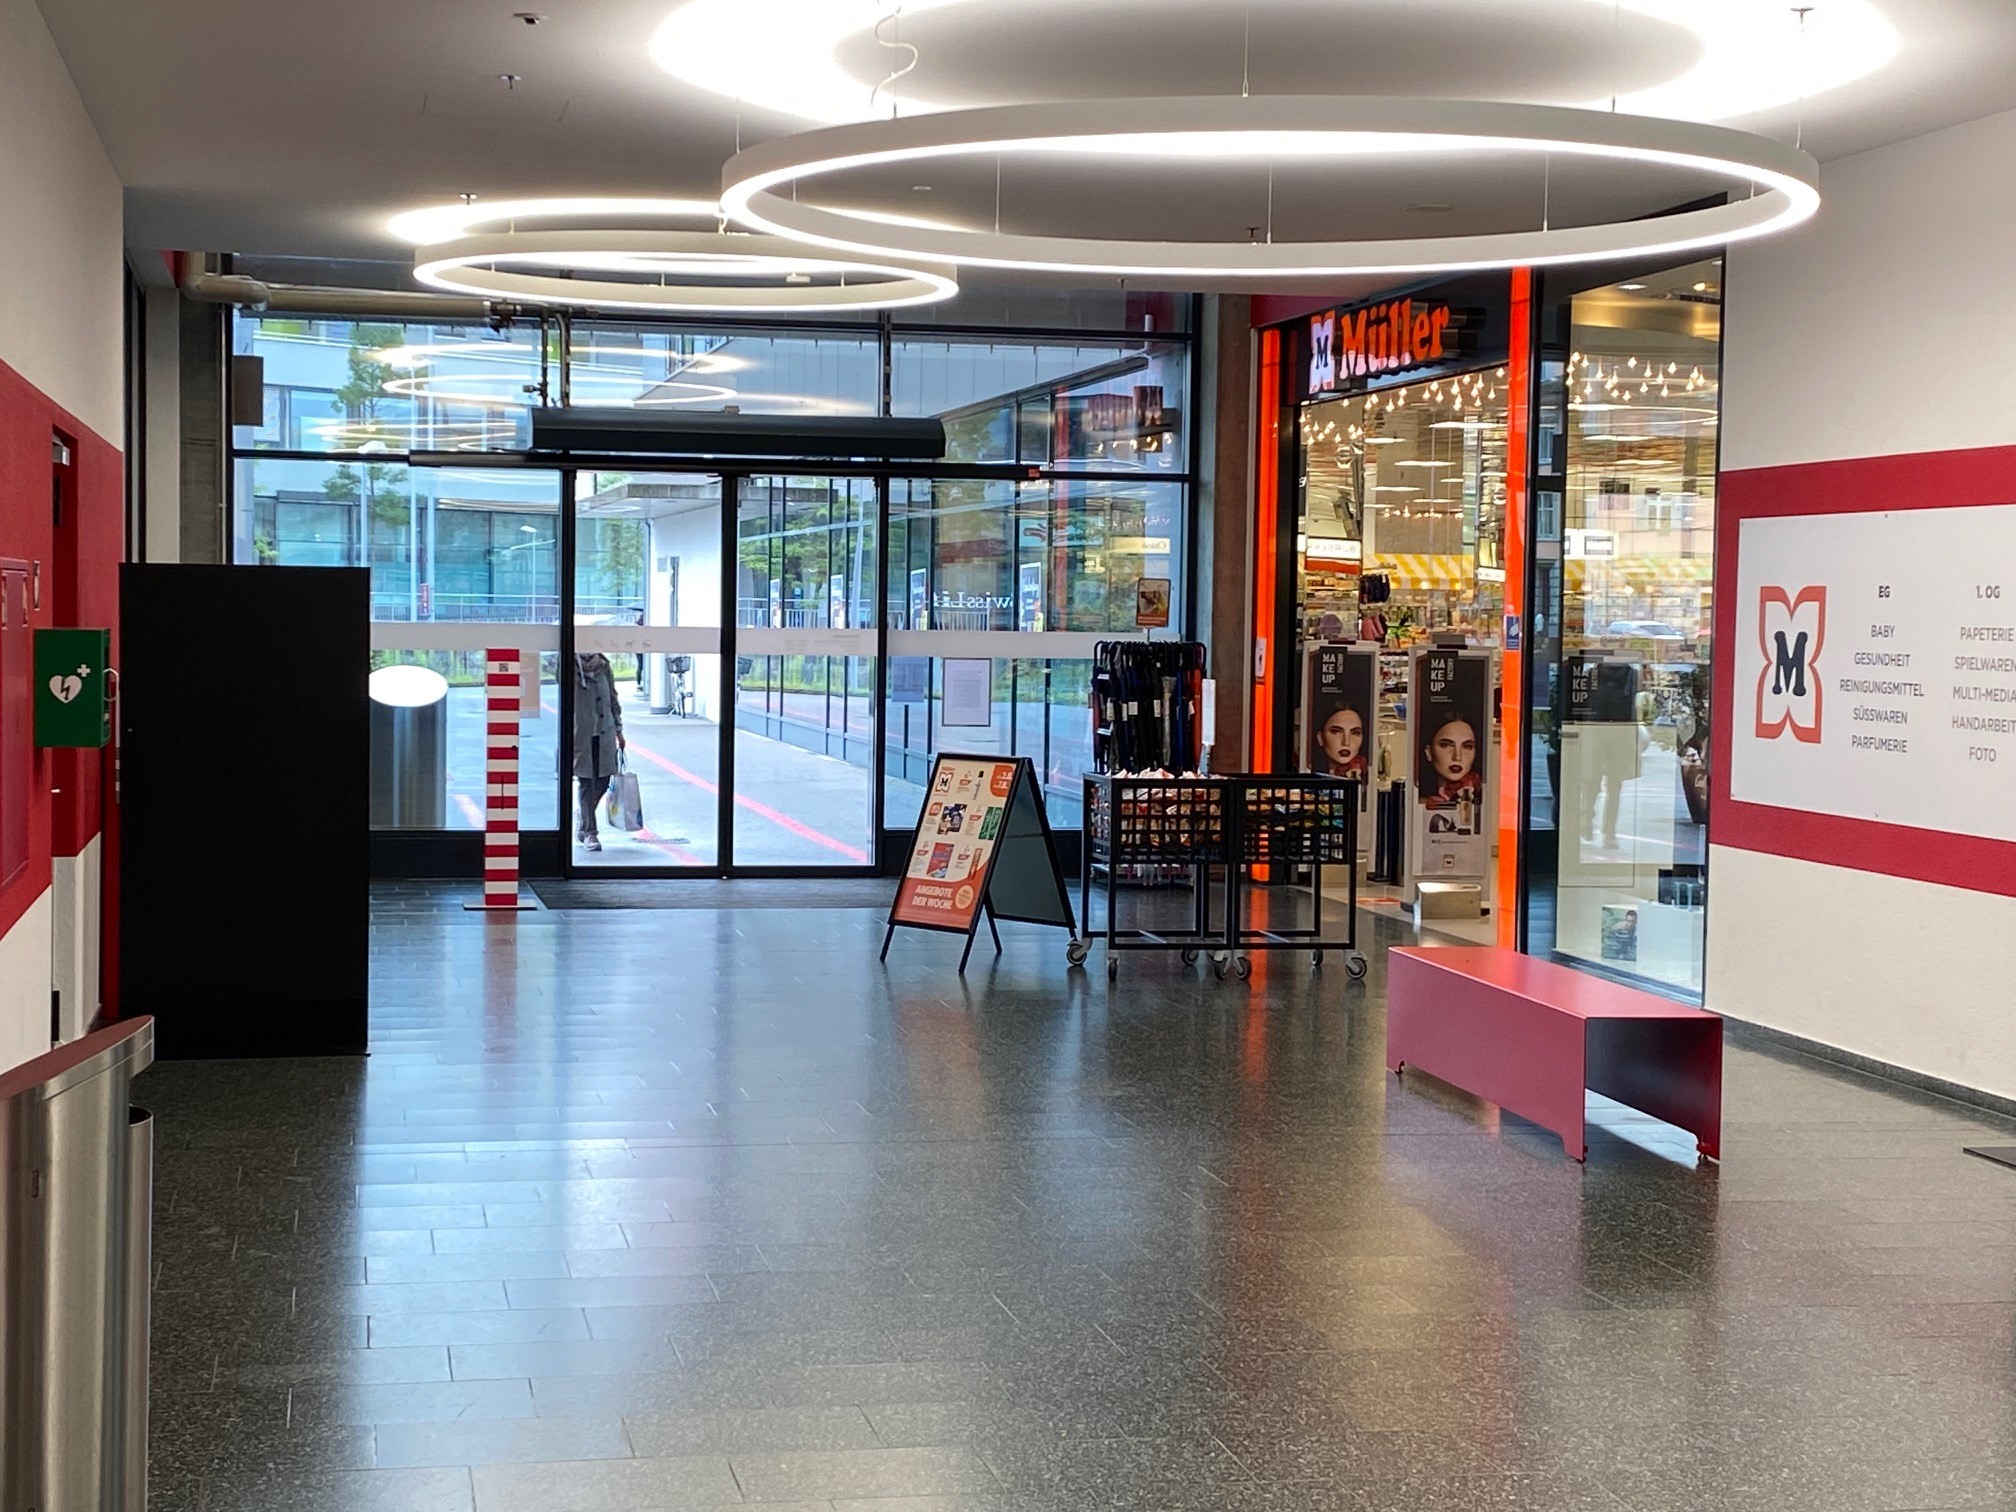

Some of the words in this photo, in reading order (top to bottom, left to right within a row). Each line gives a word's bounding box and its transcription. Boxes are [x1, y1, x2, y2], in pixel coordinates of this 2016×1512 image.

[1339, 298, 1450, 380] Müller
[1878, 585, 1891, 598] EG
[1976, 585, 1983, 599] 1.
[1985, 585, 2001, 599] OG
[1870, 625, 1896, 638] BABY
[1960, 626, 2015, 642] PAPETERIE
[1322, 653, 1336, 663] MA
[1430, 658, 1446, 669] MA
[1772, 630, 1809, 697] M
[1854, 651, 1911, 668] GESUNDHEIT
[1954, 655, 2016, 672] SPIELWAREN
[1322, 663, 1336, 673] KE
[1430, 670, 1445, 680] KE
[1322, 674, 1336, 684] UP
[1572, 678, 1588, 690] KE
[1430, 682, 1446, 692] UP
[1839, 678, 1925, 697] REINIGUNGSMITTEL
[1952, 685, 2016, 703] MULTI-MEDIA
[1572, 691, 1588, 703] UP
[1853, 705, 1908, 724] SÜSSWAREN
[1951, 715, 2016, 733] HANDARBEIT
[1851, 734, 1908, 753] PARFUMERIE
[1969, 746, 1997, 762] FOTO
[911, 895, 927, 907] DER
[927, 897, 954, 910] WOCHE
